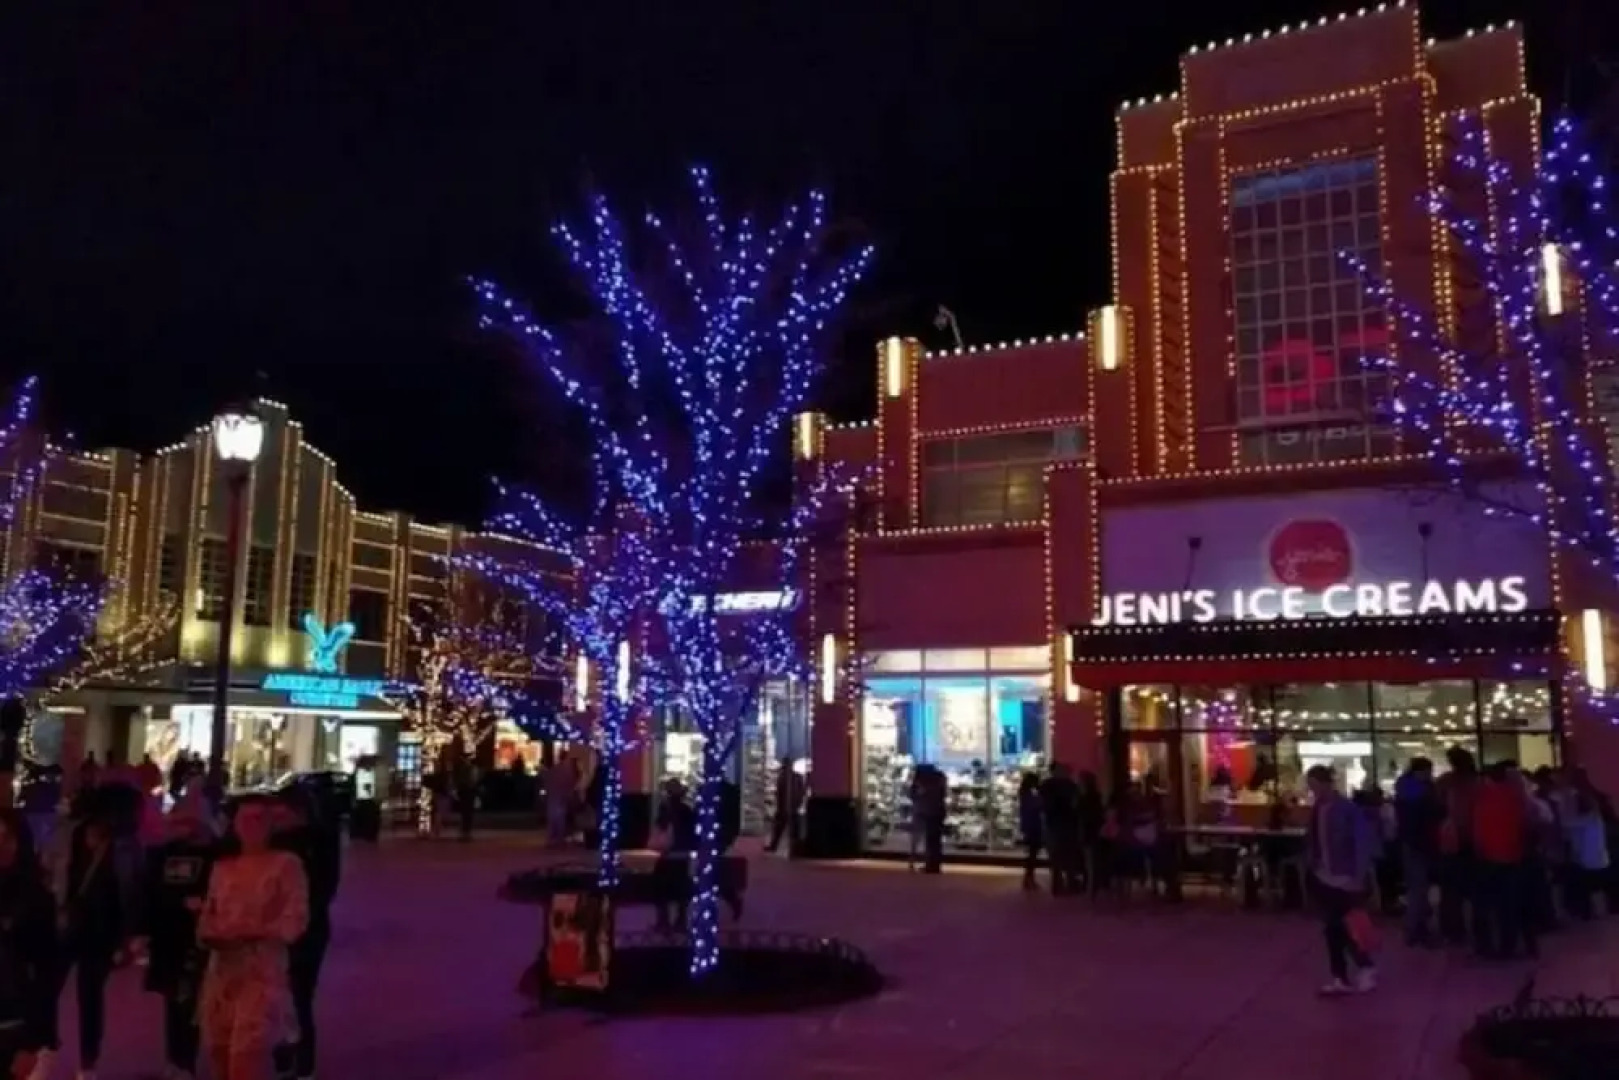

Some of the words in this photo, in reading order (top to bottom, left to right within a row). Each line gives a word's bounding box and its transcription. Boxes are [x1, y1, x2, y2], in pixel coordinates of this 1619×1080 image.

[1091, 589, 1216, 627] JENI'S
[1234, 586, 1307, 621] ICE
[1322, 576, 1529, 618] CREAMS
